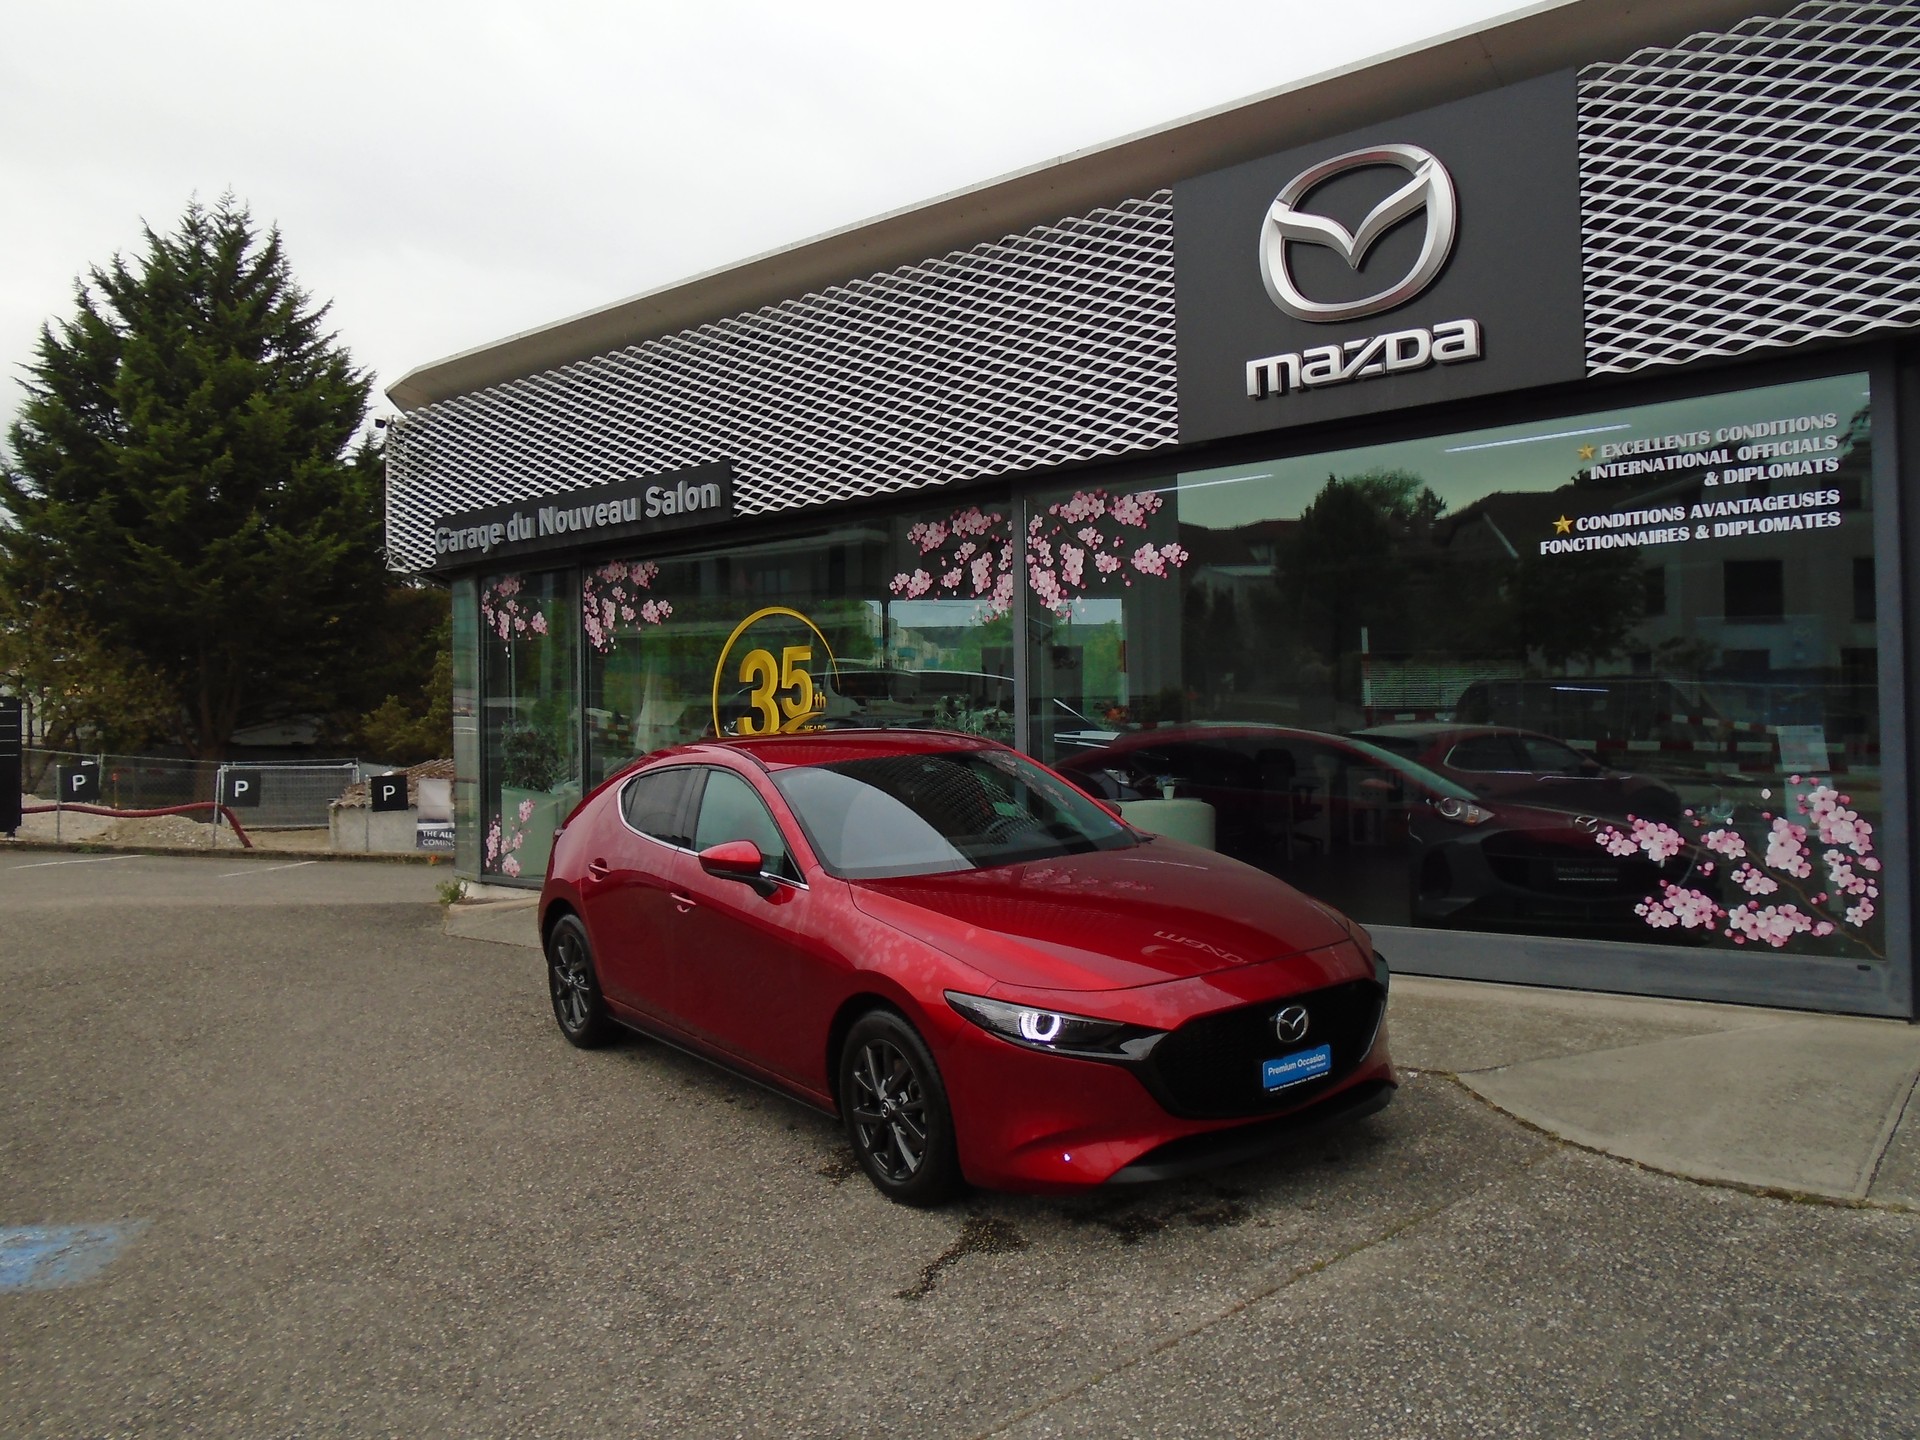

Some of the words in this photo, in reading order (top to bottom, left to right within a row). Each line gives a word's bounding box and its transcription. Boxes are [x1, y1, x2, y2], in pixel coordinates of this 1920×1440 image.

[1601, 430, 1710, 459] EXCELLENTS
[1715, 413, 1838, 443] CONDITIONS
[1590, 449, 1733, 480] INTERNATIONAL
[1737, 435, 1839, 461] OFFICIALS
[1703, 471, 1719, 486] &
[1723, 457, 1840, 485] DIPLOMATS
[435, 522, 505, 554] Garage
[506, 511, 536, 542] du
[538, 498, 641, 537] Nouveau
[645, 480, 722, 518] Salon
[1575, 506, 1686, 532] CONDITIONS
[1690, 489, 1841, 520] AVANTAGEUSES
[1540, 526, 1691, 556] FONCTIONNAIRES
[1694, 524, 1710, 540] &
[1714, 511, 1841, 538] DIPLOMATES
[72, 774, 86, 792] P
[234, 780, 249, 798] P
[382, 785, 396, 801] P
[422, 830, 437, 838] THE
[1268, 1062, 1297, 1077] Premium
[1297, 1053, 1326, 1068] Occasion
